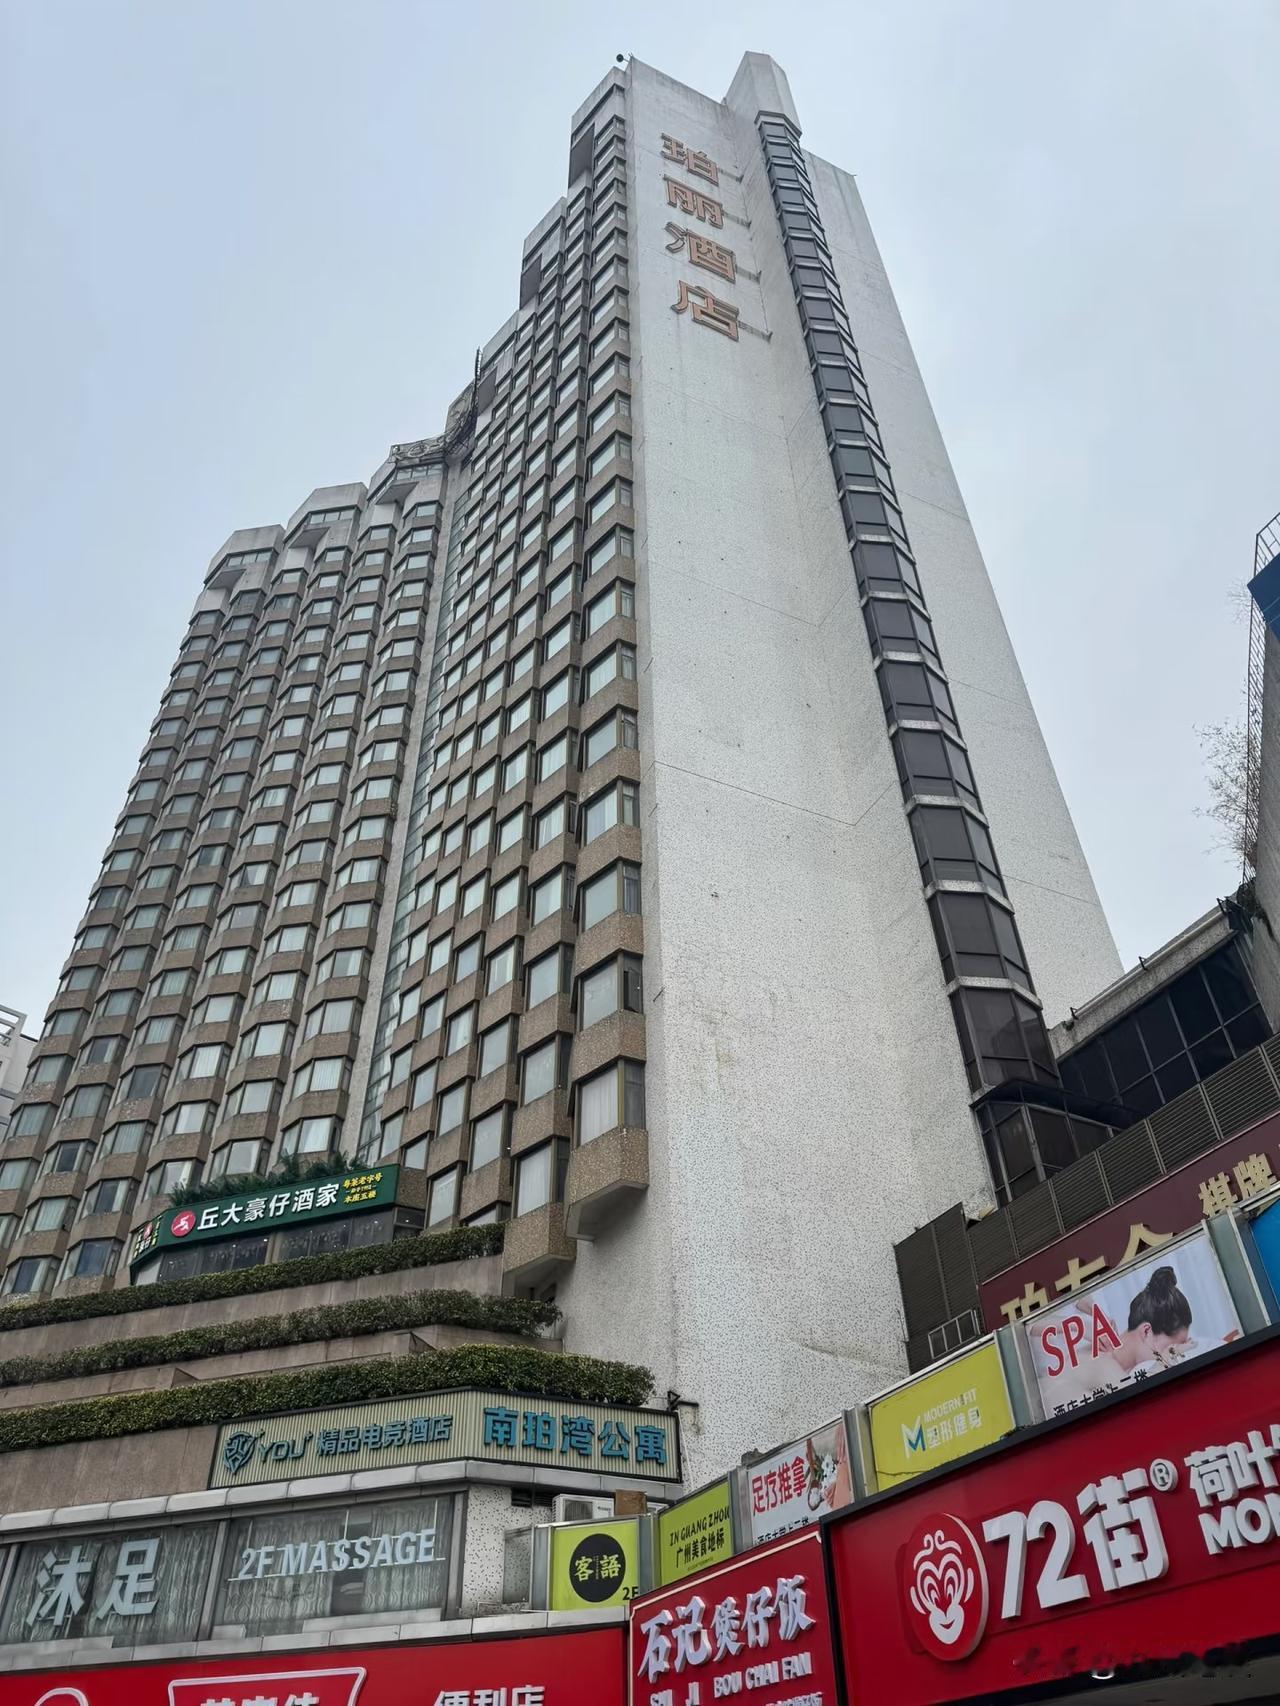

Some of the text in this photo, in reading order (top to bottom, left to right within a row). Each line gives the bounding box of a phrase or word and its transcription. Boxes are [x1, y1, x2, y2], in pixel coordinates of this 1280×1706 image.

[660, 132, 740, 342] 珀丽酒店
[197, 1183, 340, 1231] 丘大豪仔酒家
[1040, 1303, 1122, 1378] SPA
[317, 1414, 453, 1456] 精品电竞酒店
[484, 1406, 667, 1465] 南珀湾公寓
[752, 1456, 807, 1517] 足疗推拿
[238, 1528, 436, 1580] 2F MASSAGE
[575, 1554, 621, 1582] 客語
[676, 1527, 725, 1568] 广州美食地标
[26, 1537, 160, 1626] 沐足
[637, 1574, 816, 1684] 石记煲仔饭
[713, 1671, 742, 1698] BOU
[745, 1661, 779, 1690] CHAI
[781, 1652, 813, 1680] FAN
